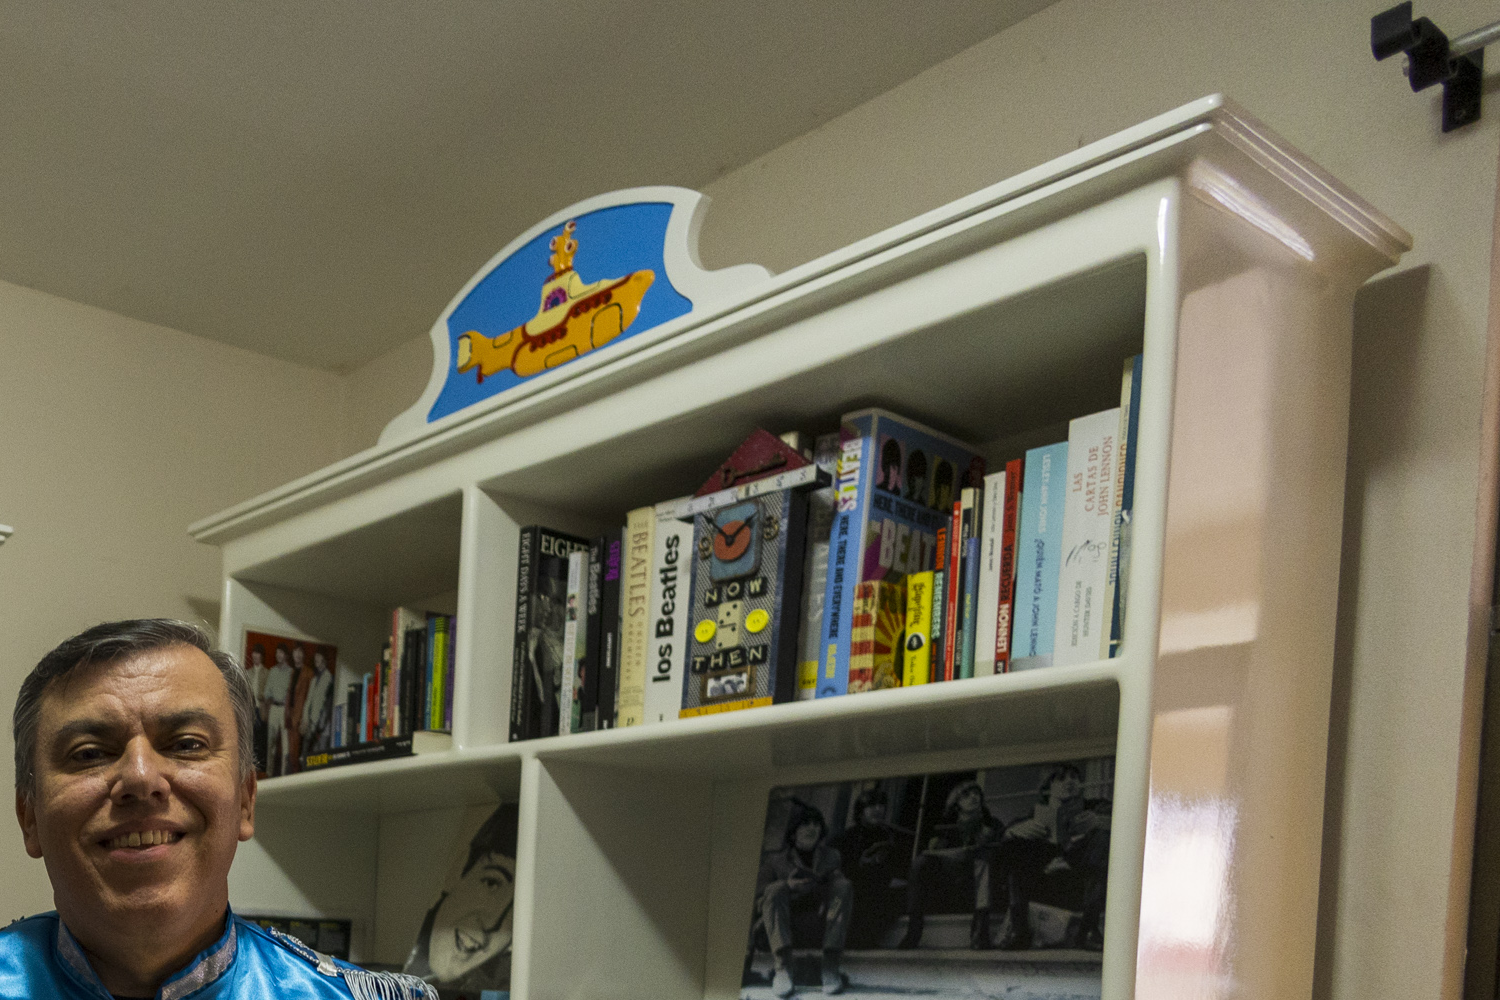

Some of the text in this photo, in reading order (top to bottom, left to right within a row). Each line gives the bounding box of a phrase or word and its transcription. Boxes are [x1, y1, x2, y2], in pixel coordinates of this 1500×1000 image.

[838, 438, 864, 512] BEATLES
[1072, 472, 1083, 493] LAS
[1085, 446, 1100, 512] CARTAS DE
[1097, 435, 1113, 516] JOHN LENNON
[520, 532, 531, 565] EIGHT
[628, 530, 649, 618] BEATLES
[878, 517, 936, 576] BEAT
[1000, 543, 1013, 600] RECUERDA
[516, 603, 527, 633] WEEK
[652, 534, 681, 683] los Beatles
[705, 579, 762, 604] NOW
[996, 603, 1009, 654] LENNON
[694, 646, 763, 671] THEN
